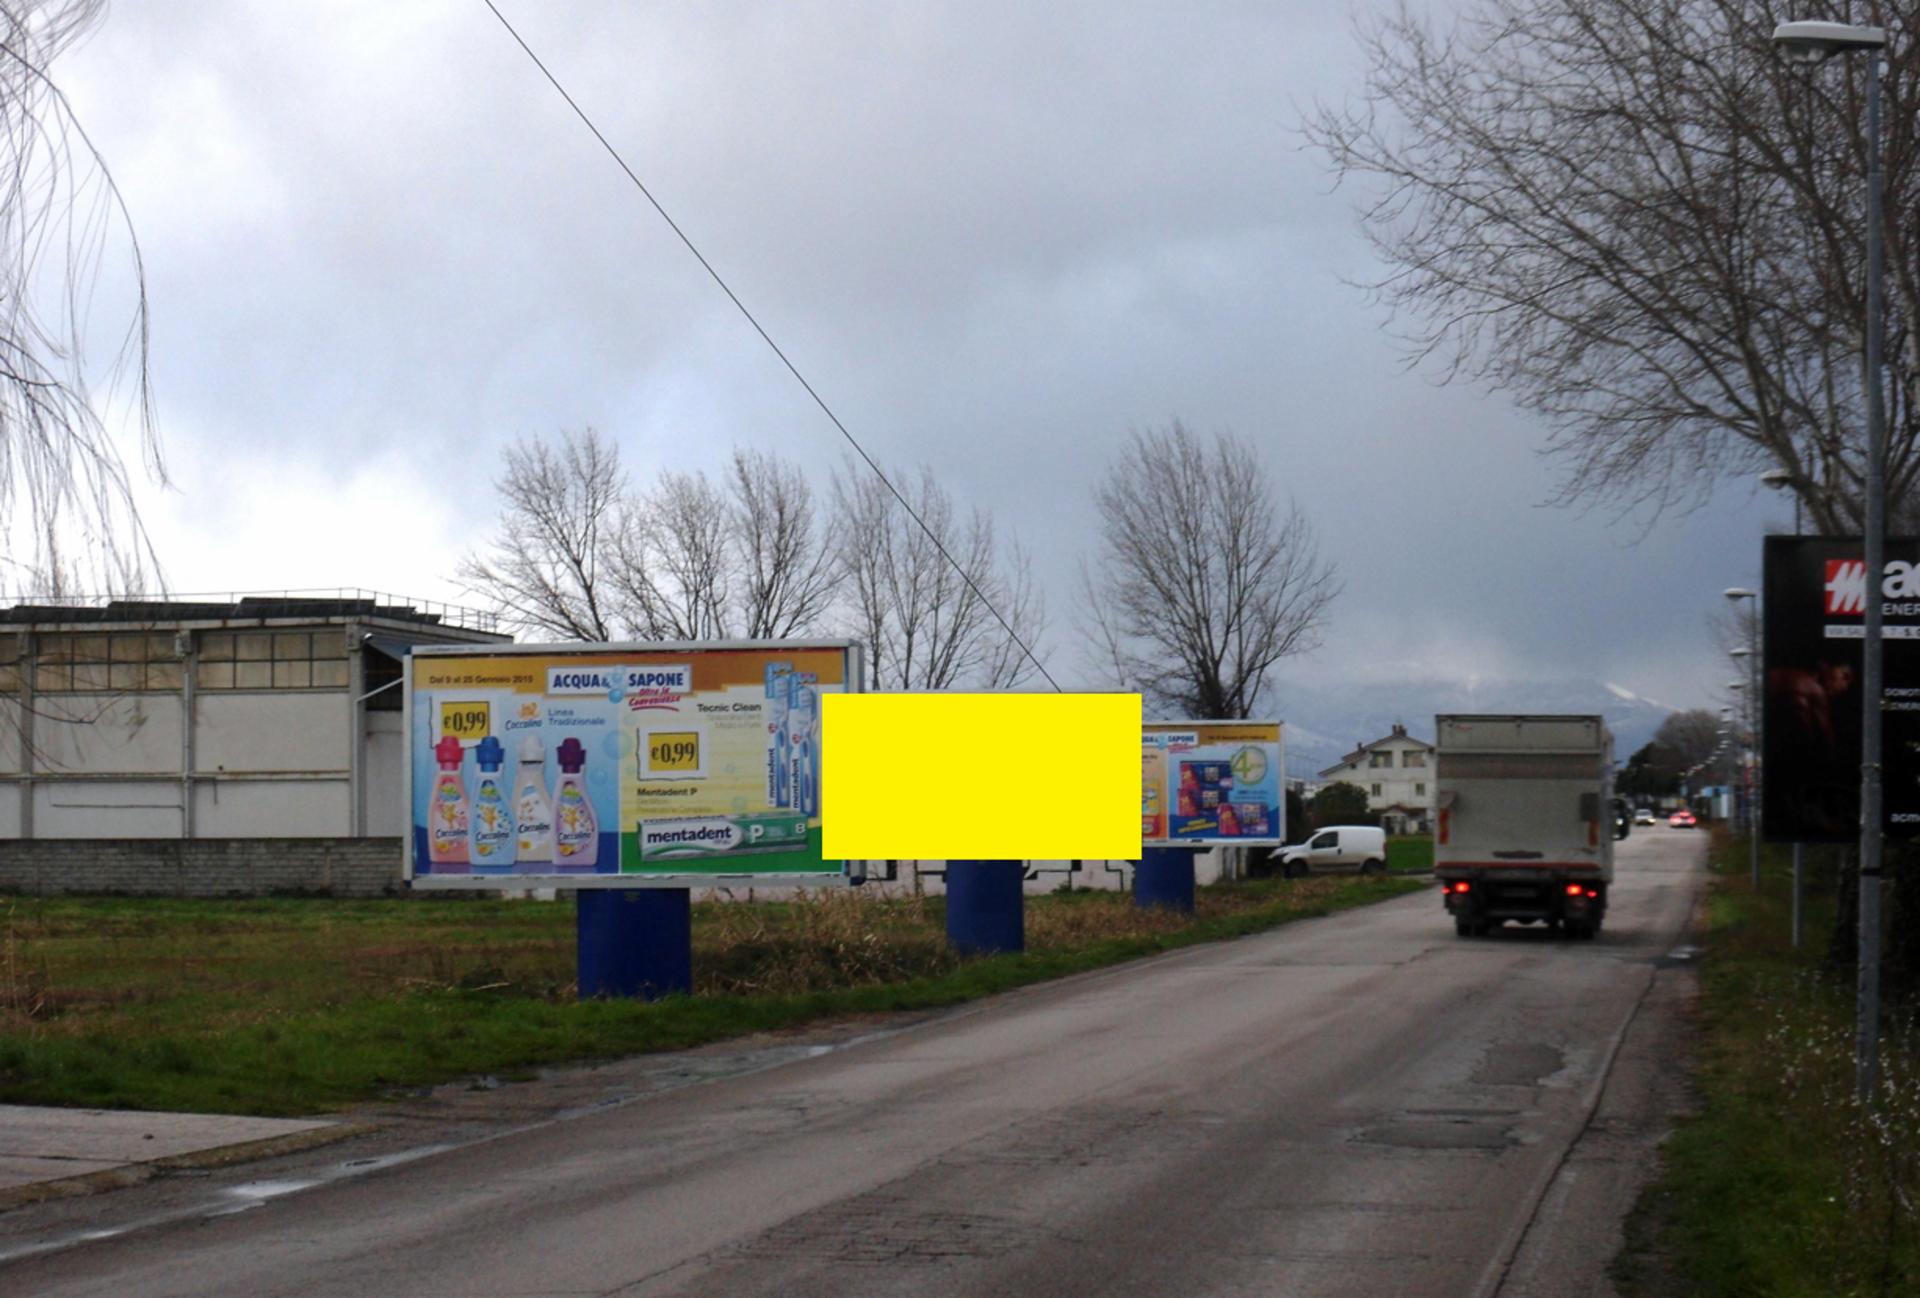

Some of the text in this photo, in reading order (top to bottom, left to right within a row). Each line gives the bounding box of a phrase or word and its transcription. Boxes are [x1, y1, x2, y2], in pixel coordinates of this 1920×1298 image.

[1881, 559, 1920, 600] a
[474, 674, 511, 684] Gennaio
[553, 673, 601, 689] ACQUA
[628, 672, 684, 688] SAPONE
[547, 707, 574, 717] Linea
[697, 702, 762, 713] Tecnic Clean
[504, 719, 543, 731] Coccolino
[547, 717, 605, 727] Tradizionale
[637, 787, 698, 797] Mentadent P
[518, 822, 550, 834] Coccolino
[647, 825, 732, 844] mentadent
[750, 823, 764, 844] P
[475, 830, 510, 842] Coccolino
[559, 831, 592, 842] Coccolino
